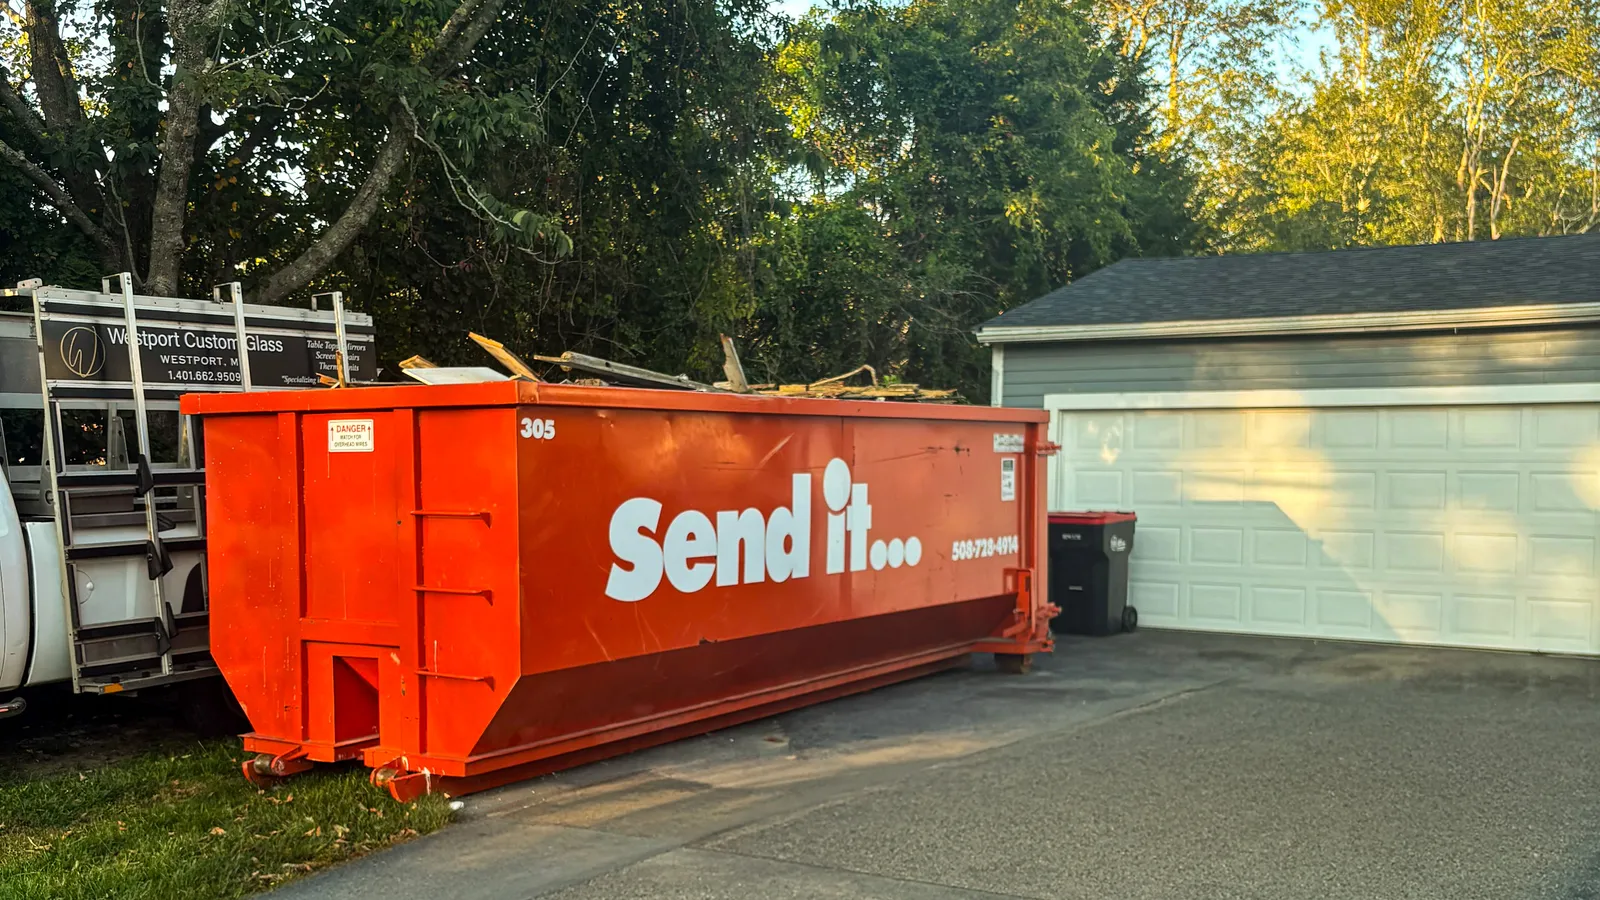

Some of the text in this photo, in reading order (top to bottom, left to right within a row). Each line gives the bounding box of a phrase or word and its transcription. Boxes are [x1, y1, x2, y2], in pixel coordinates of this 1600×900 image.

[245, 335, 284, 352] Glass
[307, 340, 323, 350] Table
[168, 370, 241, 383] 1.401.662.9509
[336, 424, 367, 433] DANGER
[520, 417, 556, 440] 305
